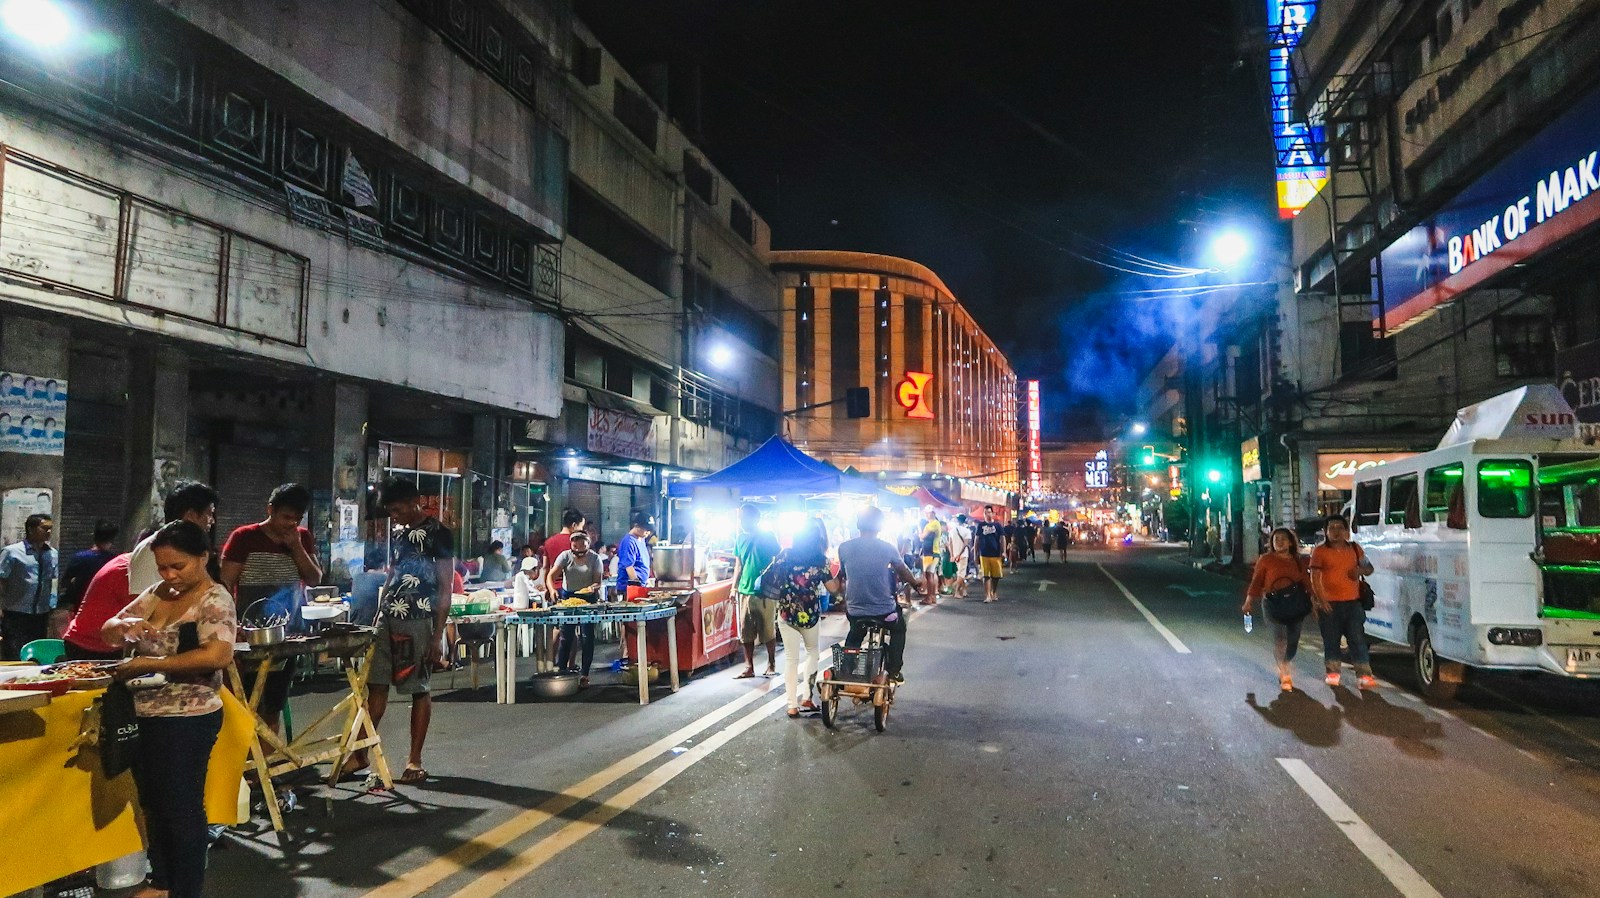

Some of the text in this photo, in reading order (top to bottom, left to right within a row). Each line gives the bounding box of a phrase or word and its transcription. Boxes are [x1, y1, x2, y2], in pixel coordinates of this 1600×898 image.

[1448, 150, 1600, 275] BANK OF MAK
[1526, 412, 1574, 426] sun
